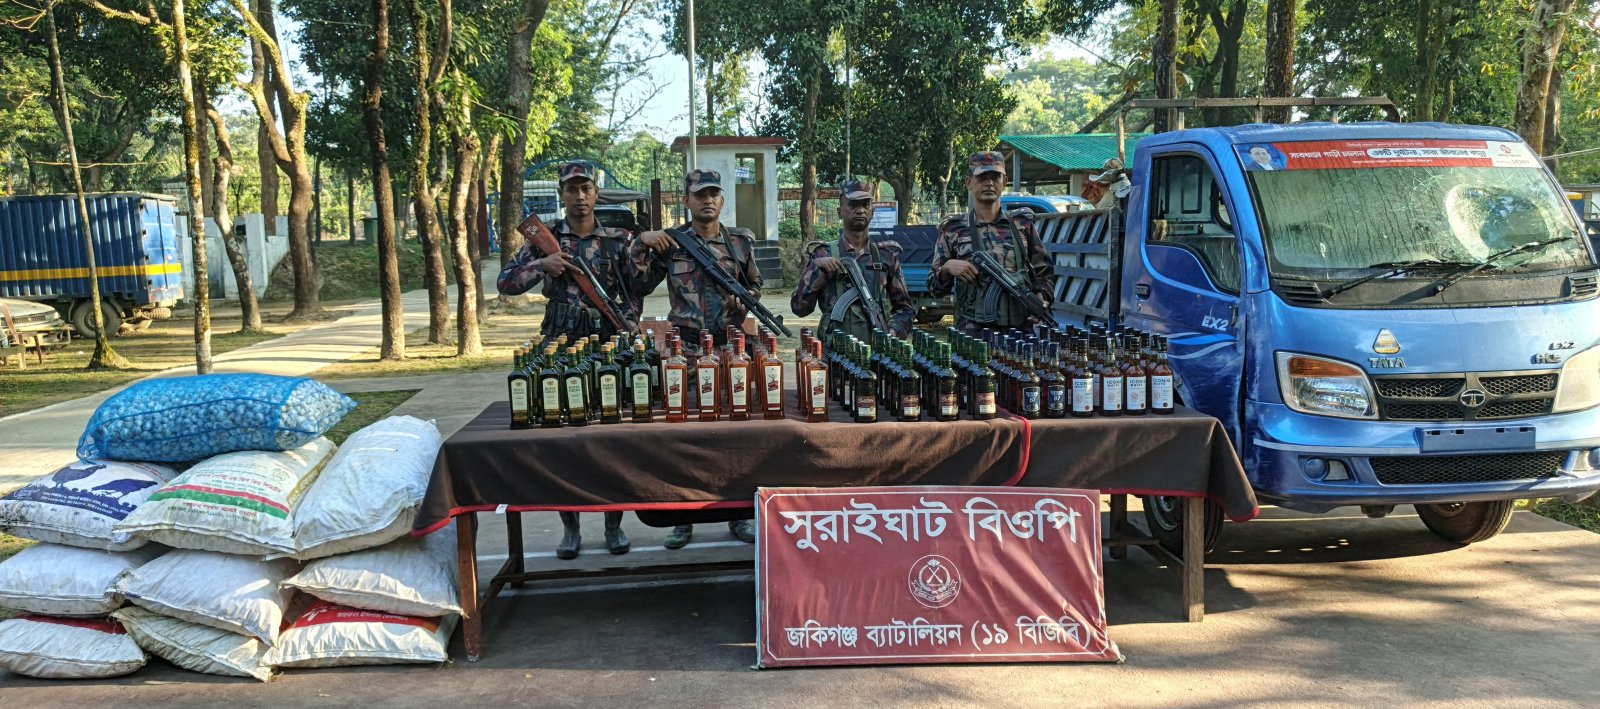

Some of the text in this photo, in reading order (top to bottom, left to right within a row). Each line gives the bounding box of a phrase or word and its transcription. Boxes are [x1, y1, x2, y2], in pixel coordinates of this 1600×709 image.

[1201, 315, 1229, 331] EX2
[1368, 357, 1406, 368] TATA
[779, 497, 1082, 553] সুরাইঘাট বিওপি
[784, 615, 1091, 652] জকিগঞ্জ ব্যাটালিয়ন (১৯ বিজিবি)
